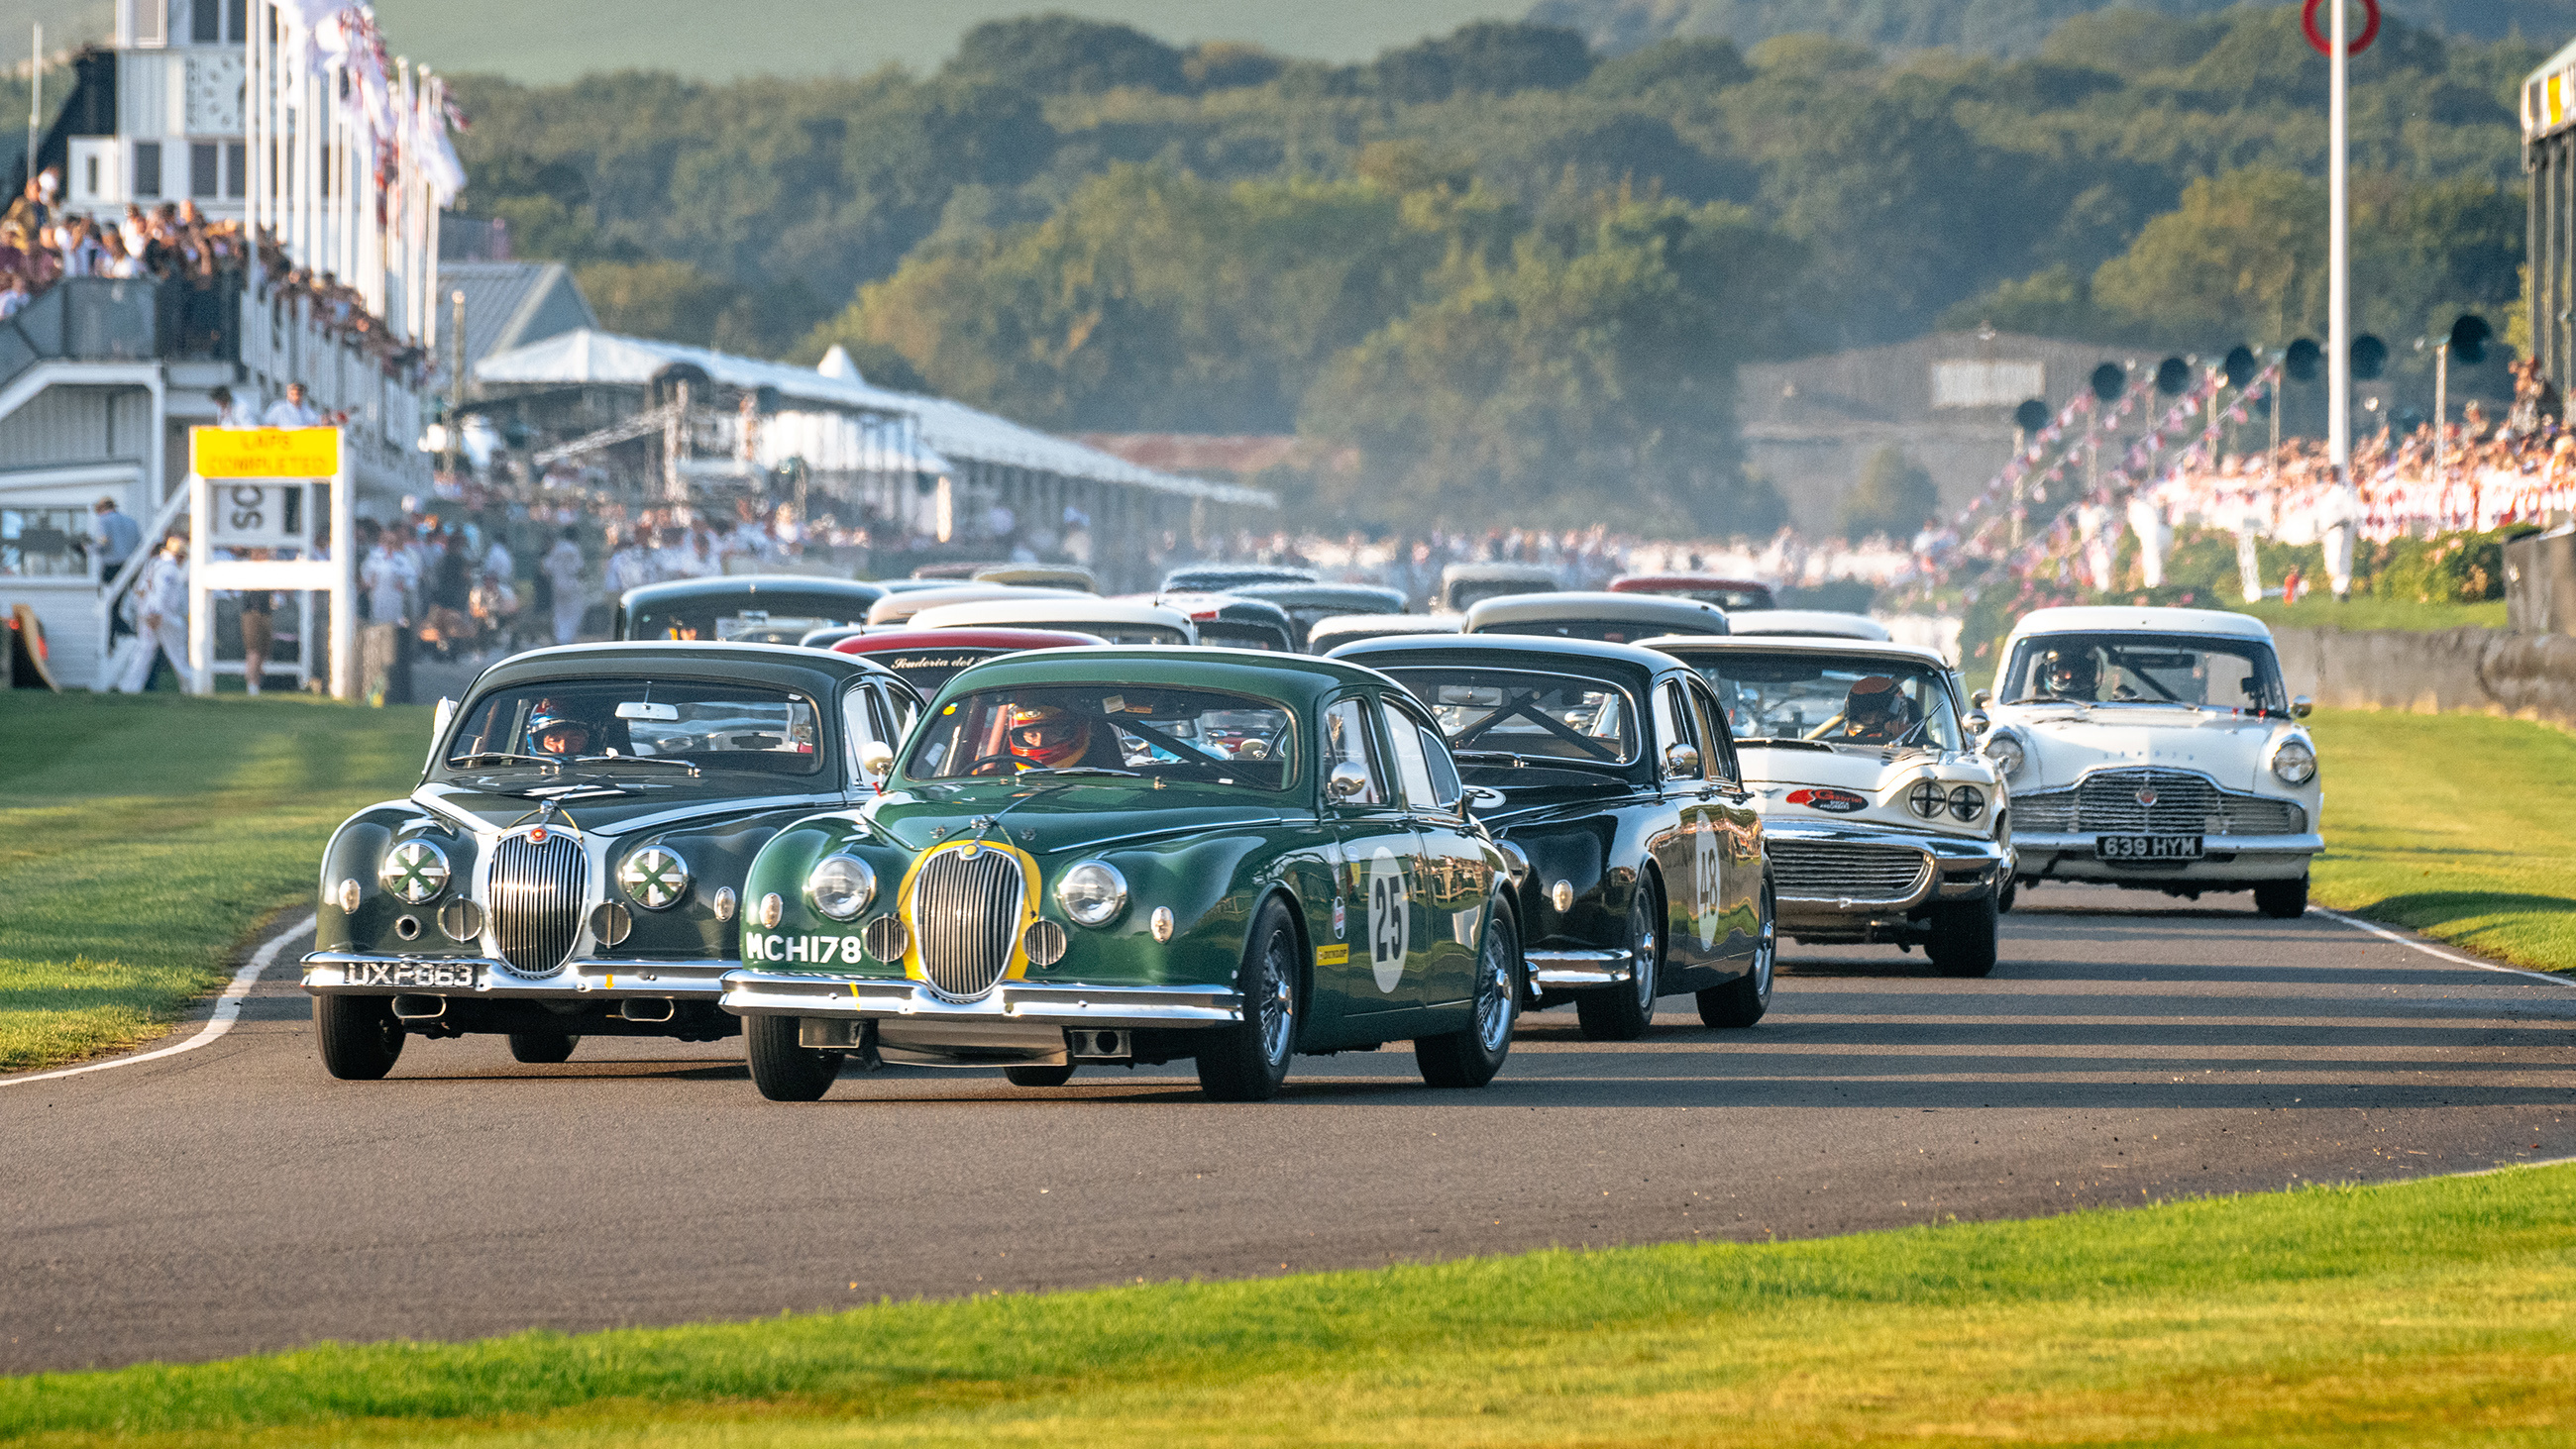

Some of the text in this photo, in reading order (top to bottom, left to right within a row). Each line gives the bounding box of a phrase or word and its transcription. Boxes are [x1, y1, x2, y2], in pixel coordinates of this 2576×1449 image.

[240, 432, 294, 452] LAPS
[208, 456, 329, 475] COMPLETED
[891, 656, 948, 670] Scuderia
[951, 656, 975, 668] del
[1814, 789, 1864, 803] Gabriel
[2104, 837, 2196, 856] 639 HYM
[1699, 848, 1719, 919] 48
[1375, 877, 1403, 962] 25
[746, 931, 862, 964] MCH178
[347, 962, 474, 986] UXP863
